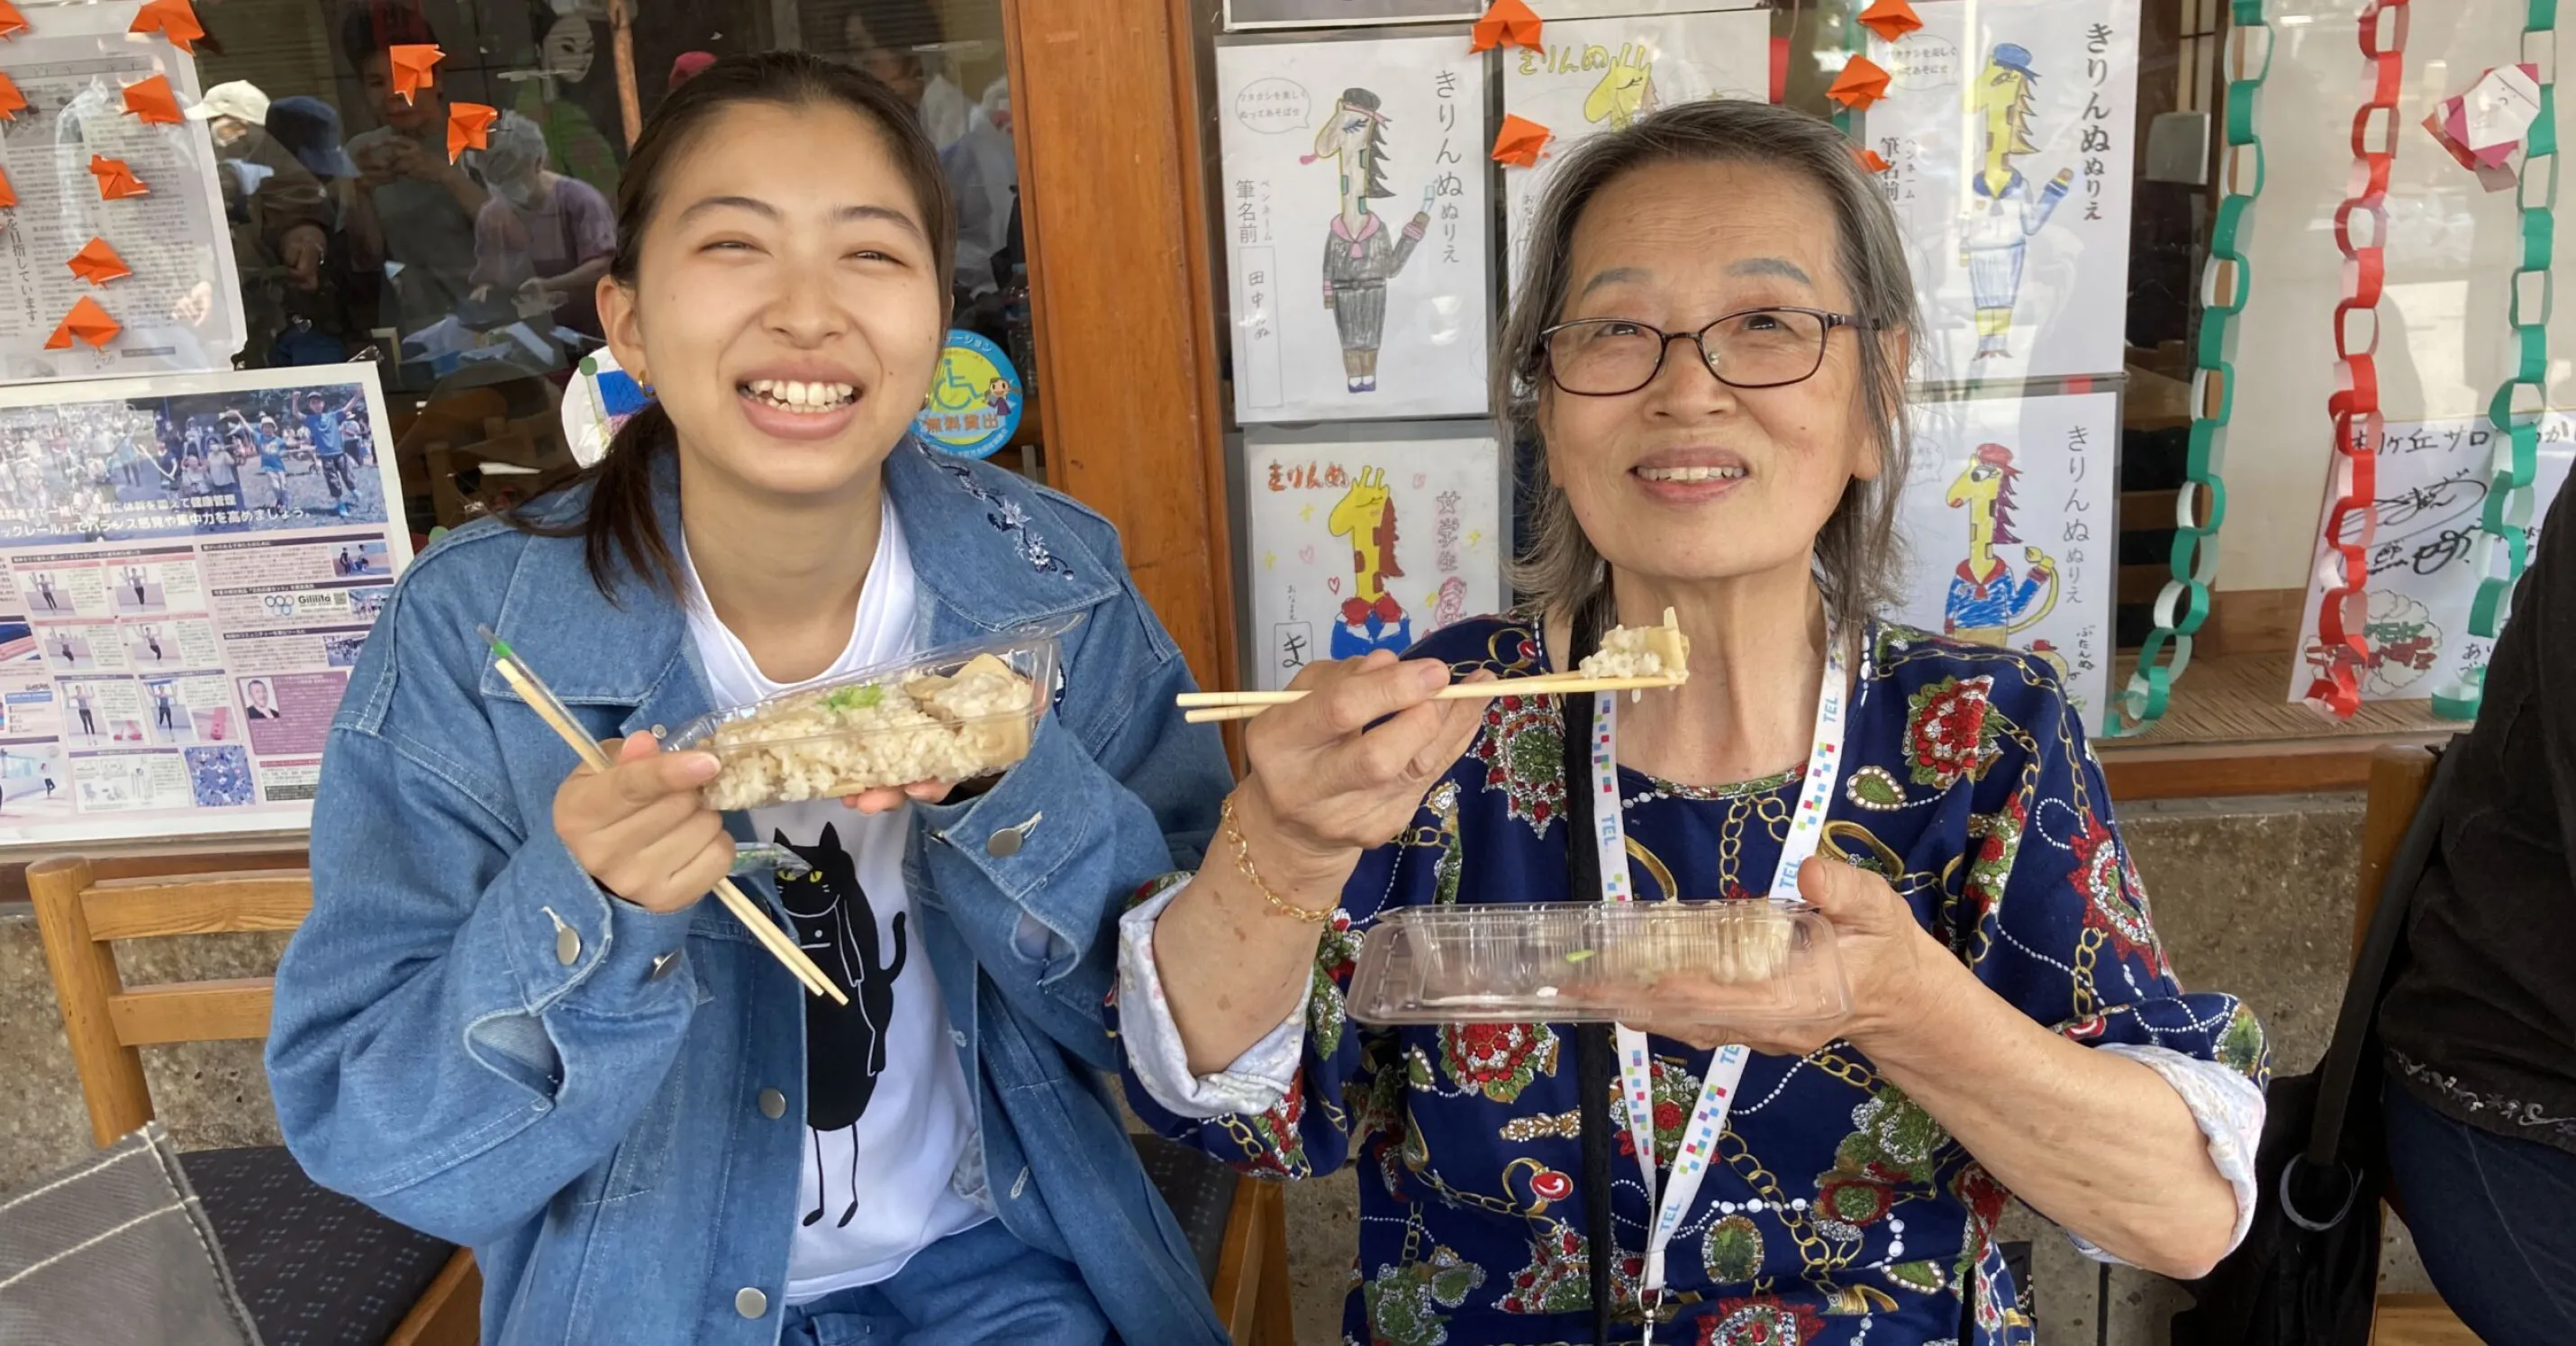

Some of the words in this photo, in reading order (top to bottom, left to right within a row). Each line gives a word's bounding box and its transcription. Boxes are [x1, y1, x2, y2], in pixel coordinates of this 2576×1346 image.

[2079, 22, 2113, 222] きりんぬぬりえ
[1435, 69, 1464, 264] きりんぬぬりえ
[1236, 179, 1257, 244] 筆名前
[2063, 424, 2090, 605] きりんぬぬりえ
[1822, 697, 1839, 723] TEL
[1601, 814, 1617, 847] TEL
[1778, 859, 1801, 887] TEL
[1719, 1044, 1740, 1064] TE
[1658, 1204, 1681, 1232] TEL
